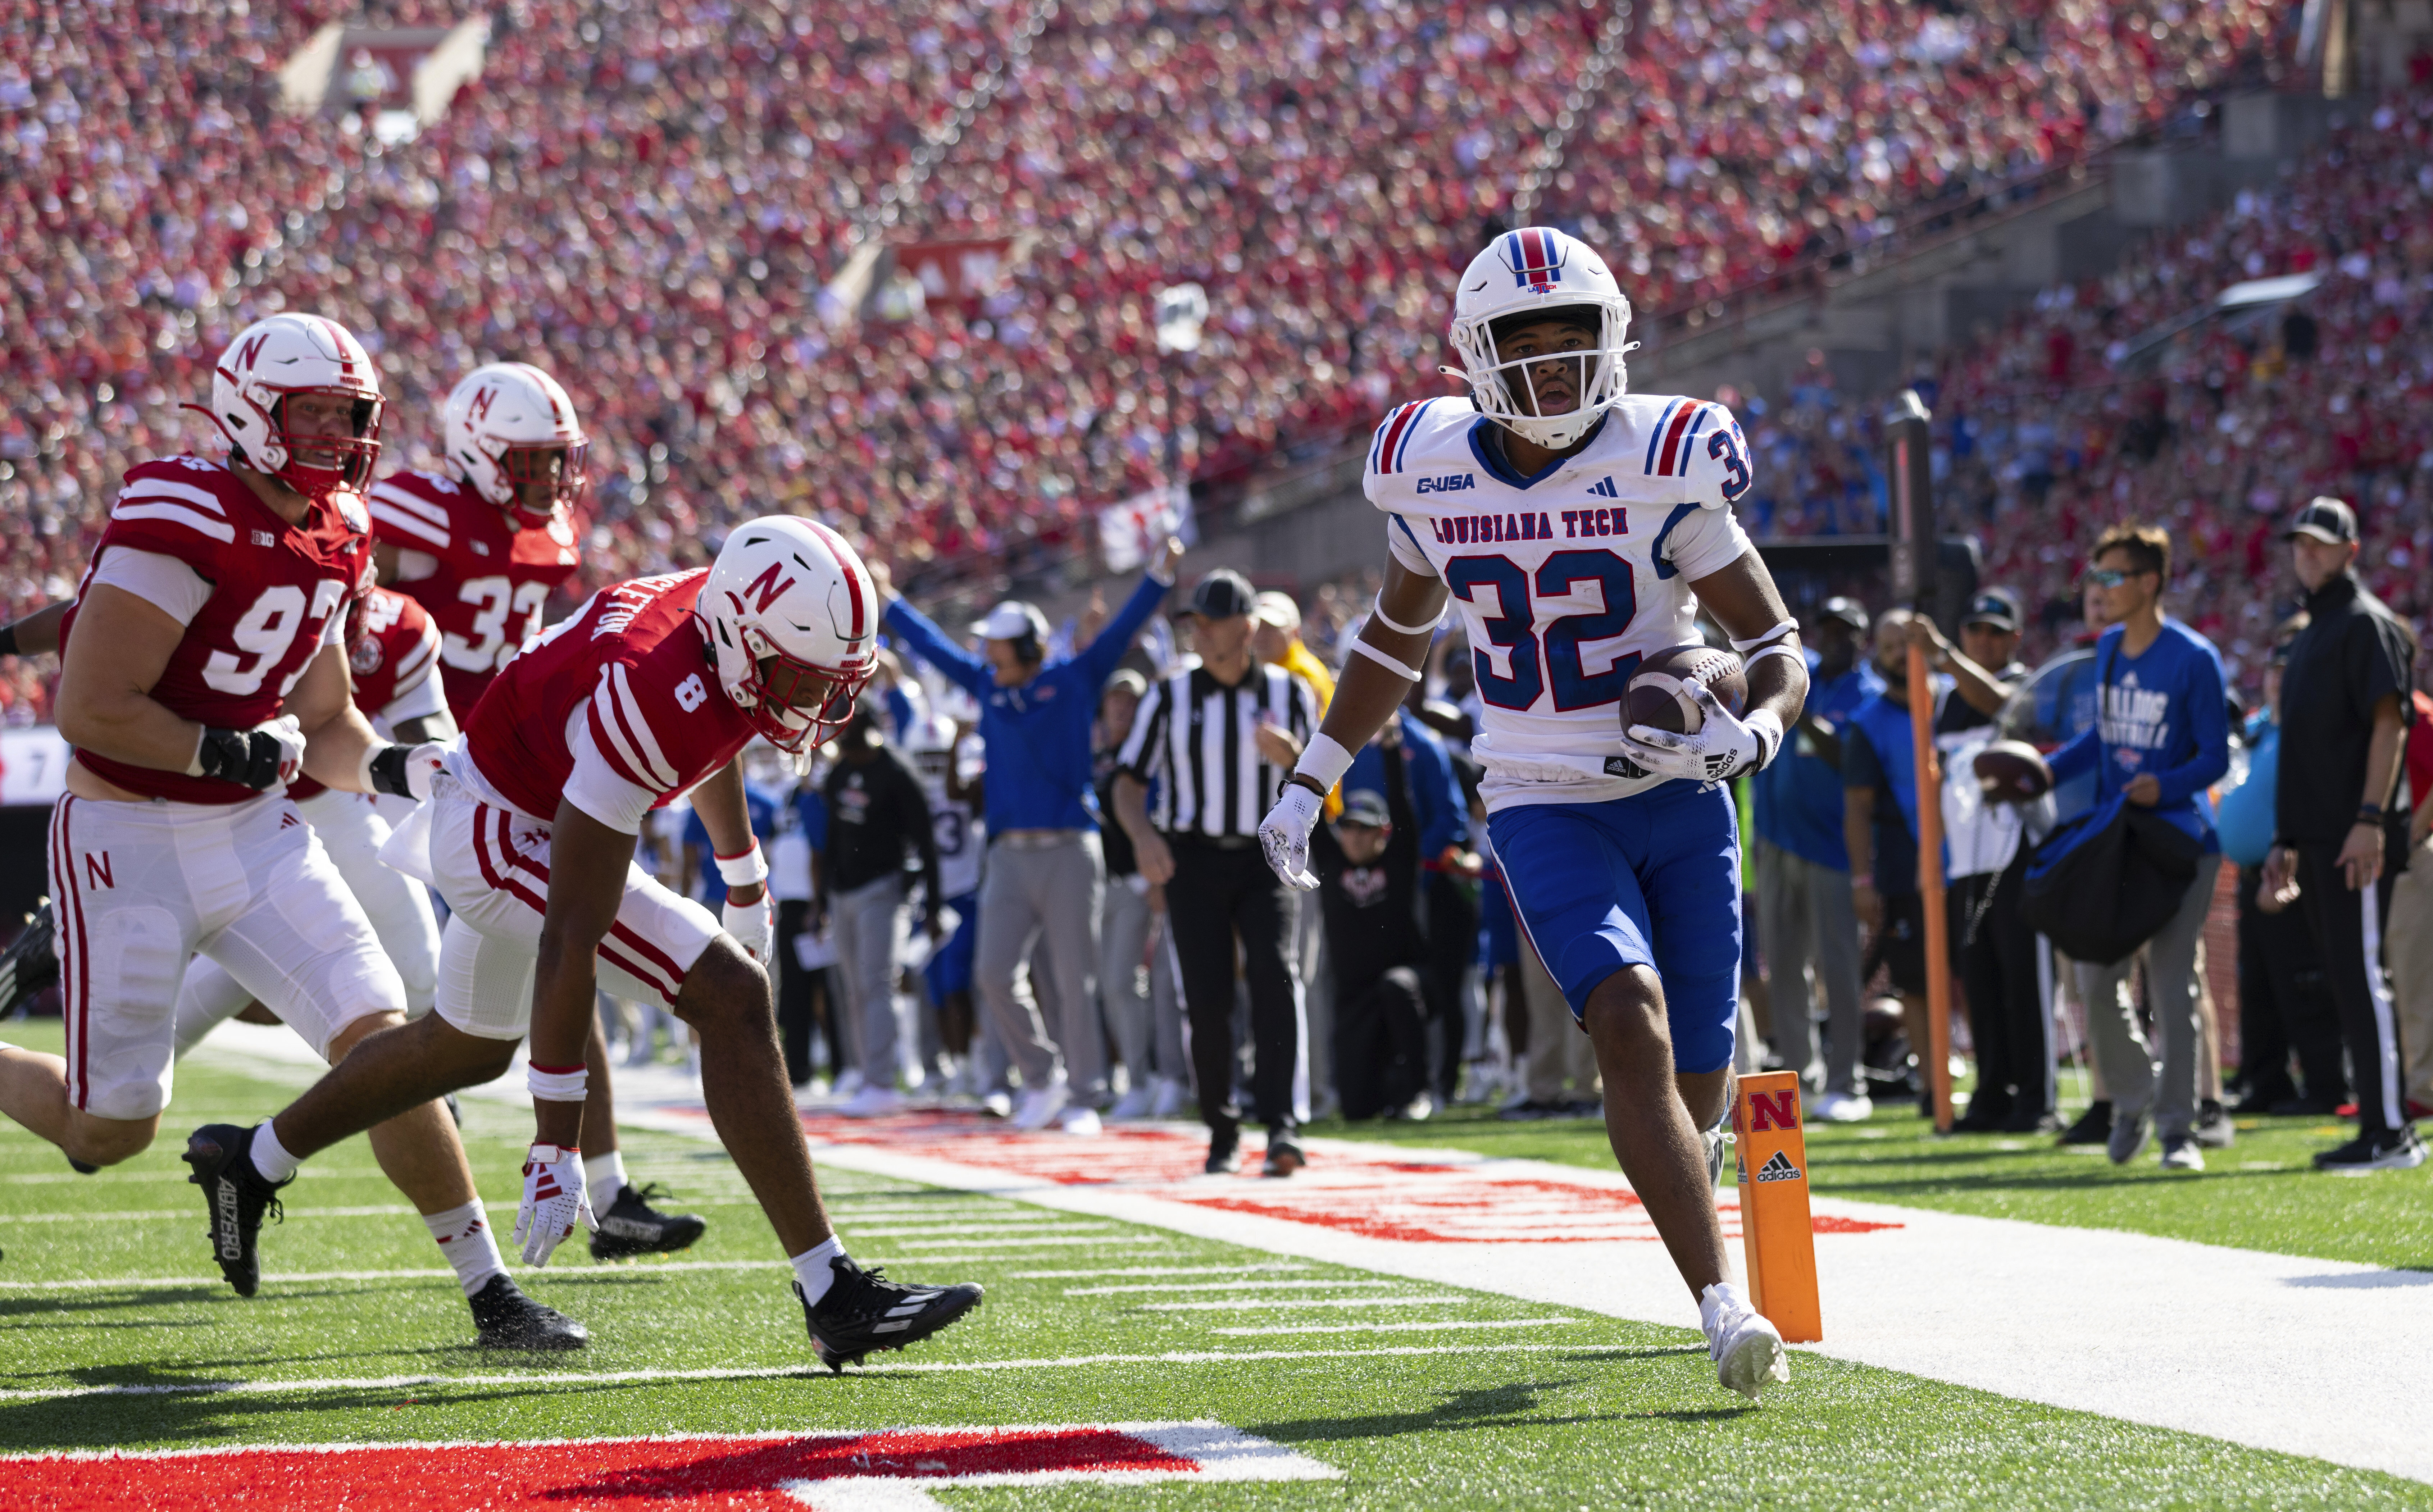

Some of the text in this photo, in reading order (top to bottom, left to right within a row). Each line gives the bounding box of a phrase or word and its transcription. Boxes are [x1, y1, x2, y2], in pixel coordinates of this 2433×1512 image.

[235, 334, 270, 372] N
[468, 387, 498, 421] N
[1429, 507, 1628, 544] LOUISIANA TECH
[743, 561, 796, 615] N
[201, 579, 348, 697] 97
[441, 575, 551, 675] 33
[1444, 548, 1643, 712] 32
[675, 672, 708, 713] 8
[1710, 748, 1737, 778] adidas
[85, 851, 115, 891] N
[1748, 1089, 1797, 1132] N
[1757, 1169, 1801, 1182] adidas
[218, 1175, 242, 1260] ADIZERO
